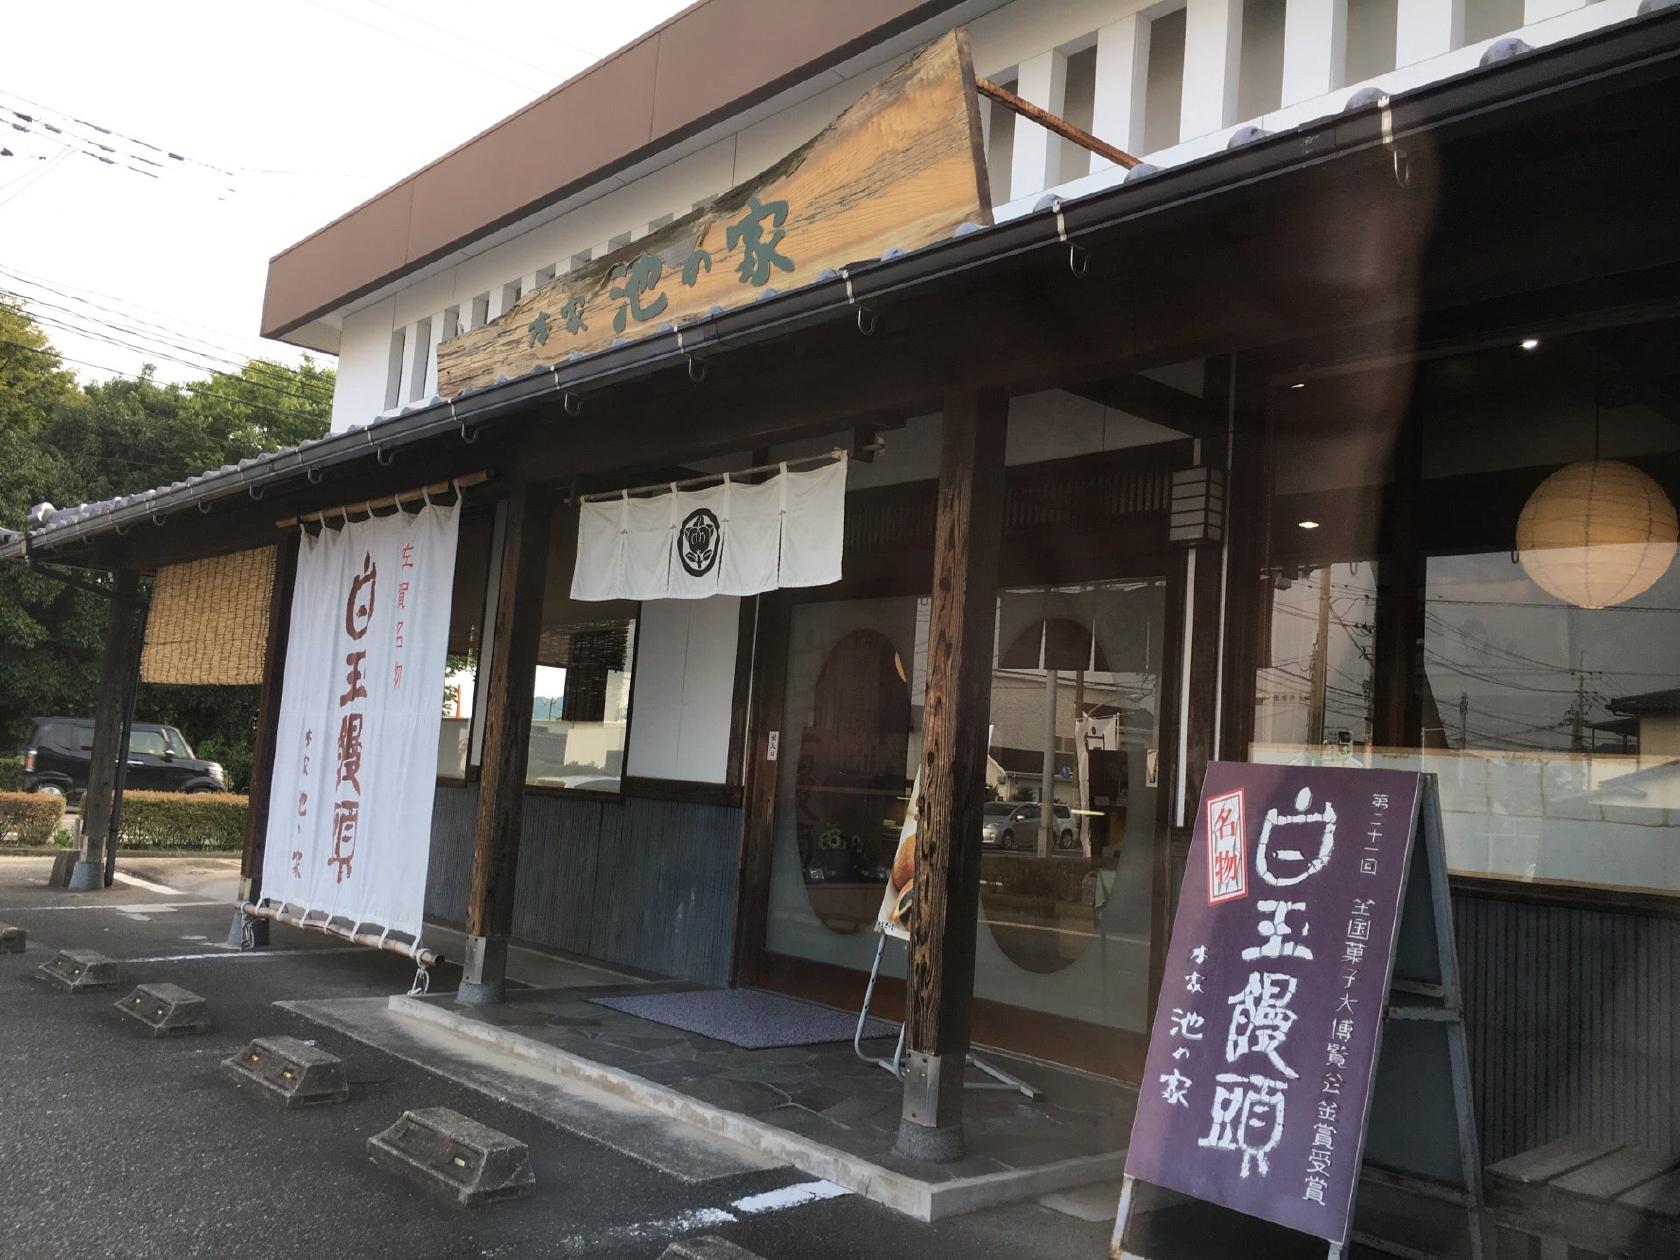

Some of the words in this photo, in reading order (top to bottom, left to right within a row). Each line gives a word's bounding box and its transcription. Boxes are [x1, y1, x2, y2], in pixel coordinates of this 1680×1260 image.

[1215, 807, 1238, 884] 名物
[1359, 793, 1390, 876] 第二十一回
[1159, 945, 1209, 1109] 本家池の家
[1197, 786, 1338, 1179] 白玉饅頭
